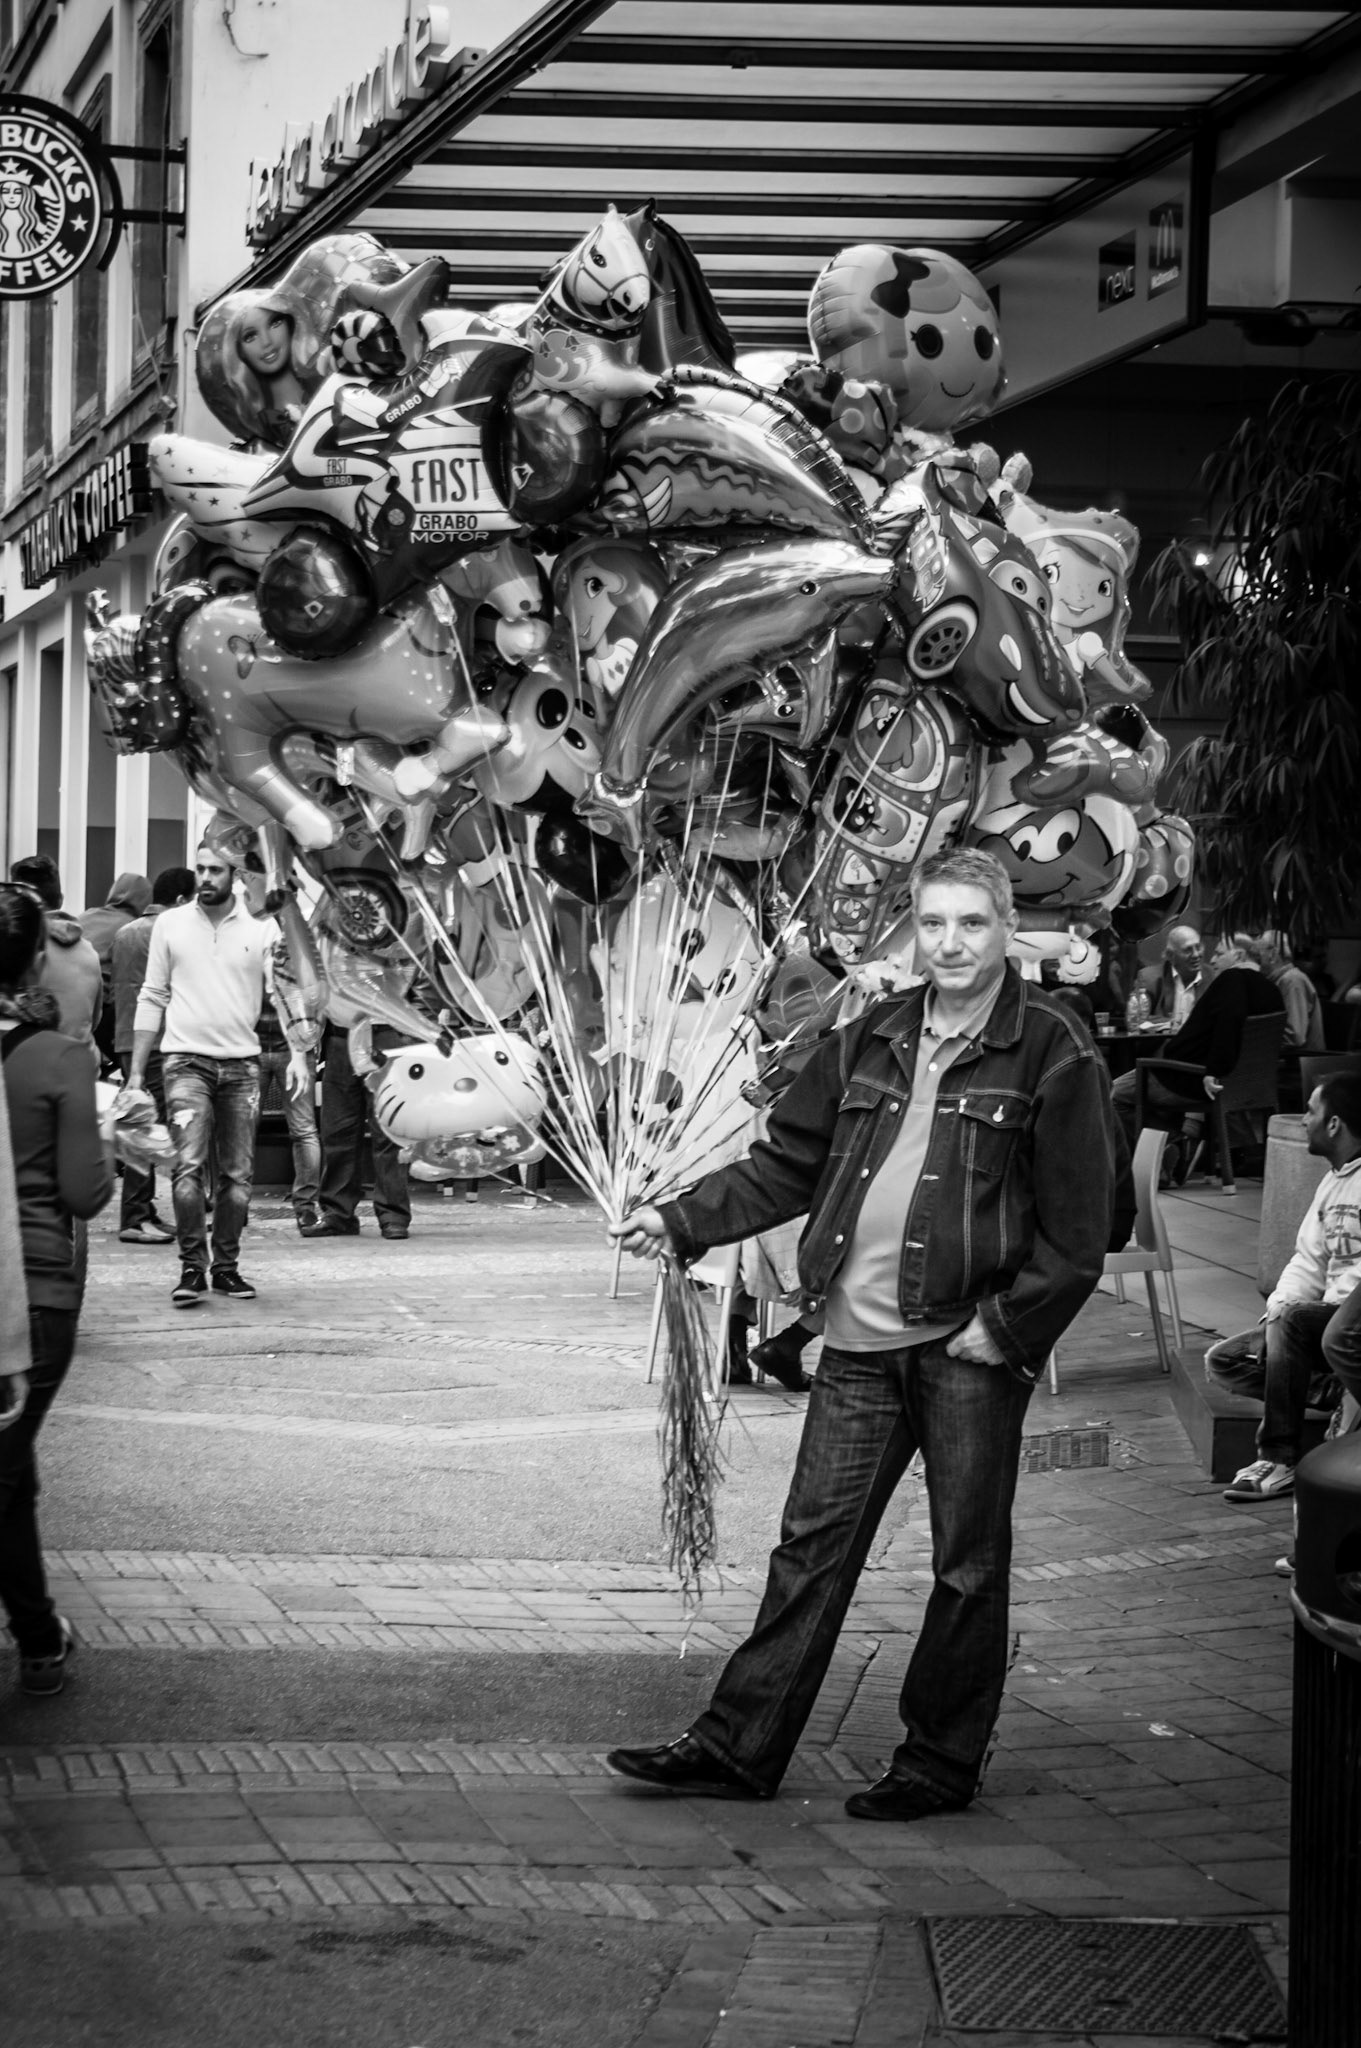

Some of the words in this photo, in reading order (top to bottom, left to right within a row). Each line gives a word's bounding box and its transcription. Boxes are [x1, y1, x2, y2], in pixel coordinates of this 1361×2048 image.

[0, 124, 91, 203] BUCKS
[385, 394, 422, 423] GRABO
[327, 458, 347, 474] FAST
[323, 475, 352, 486] GRABO
[411, 457, 481, 504] FAST
[84, 444, 135, 543] COFFEE
[419, 514, 478, 530] GRABO
[410, 531, 490, 544] MOTOR
